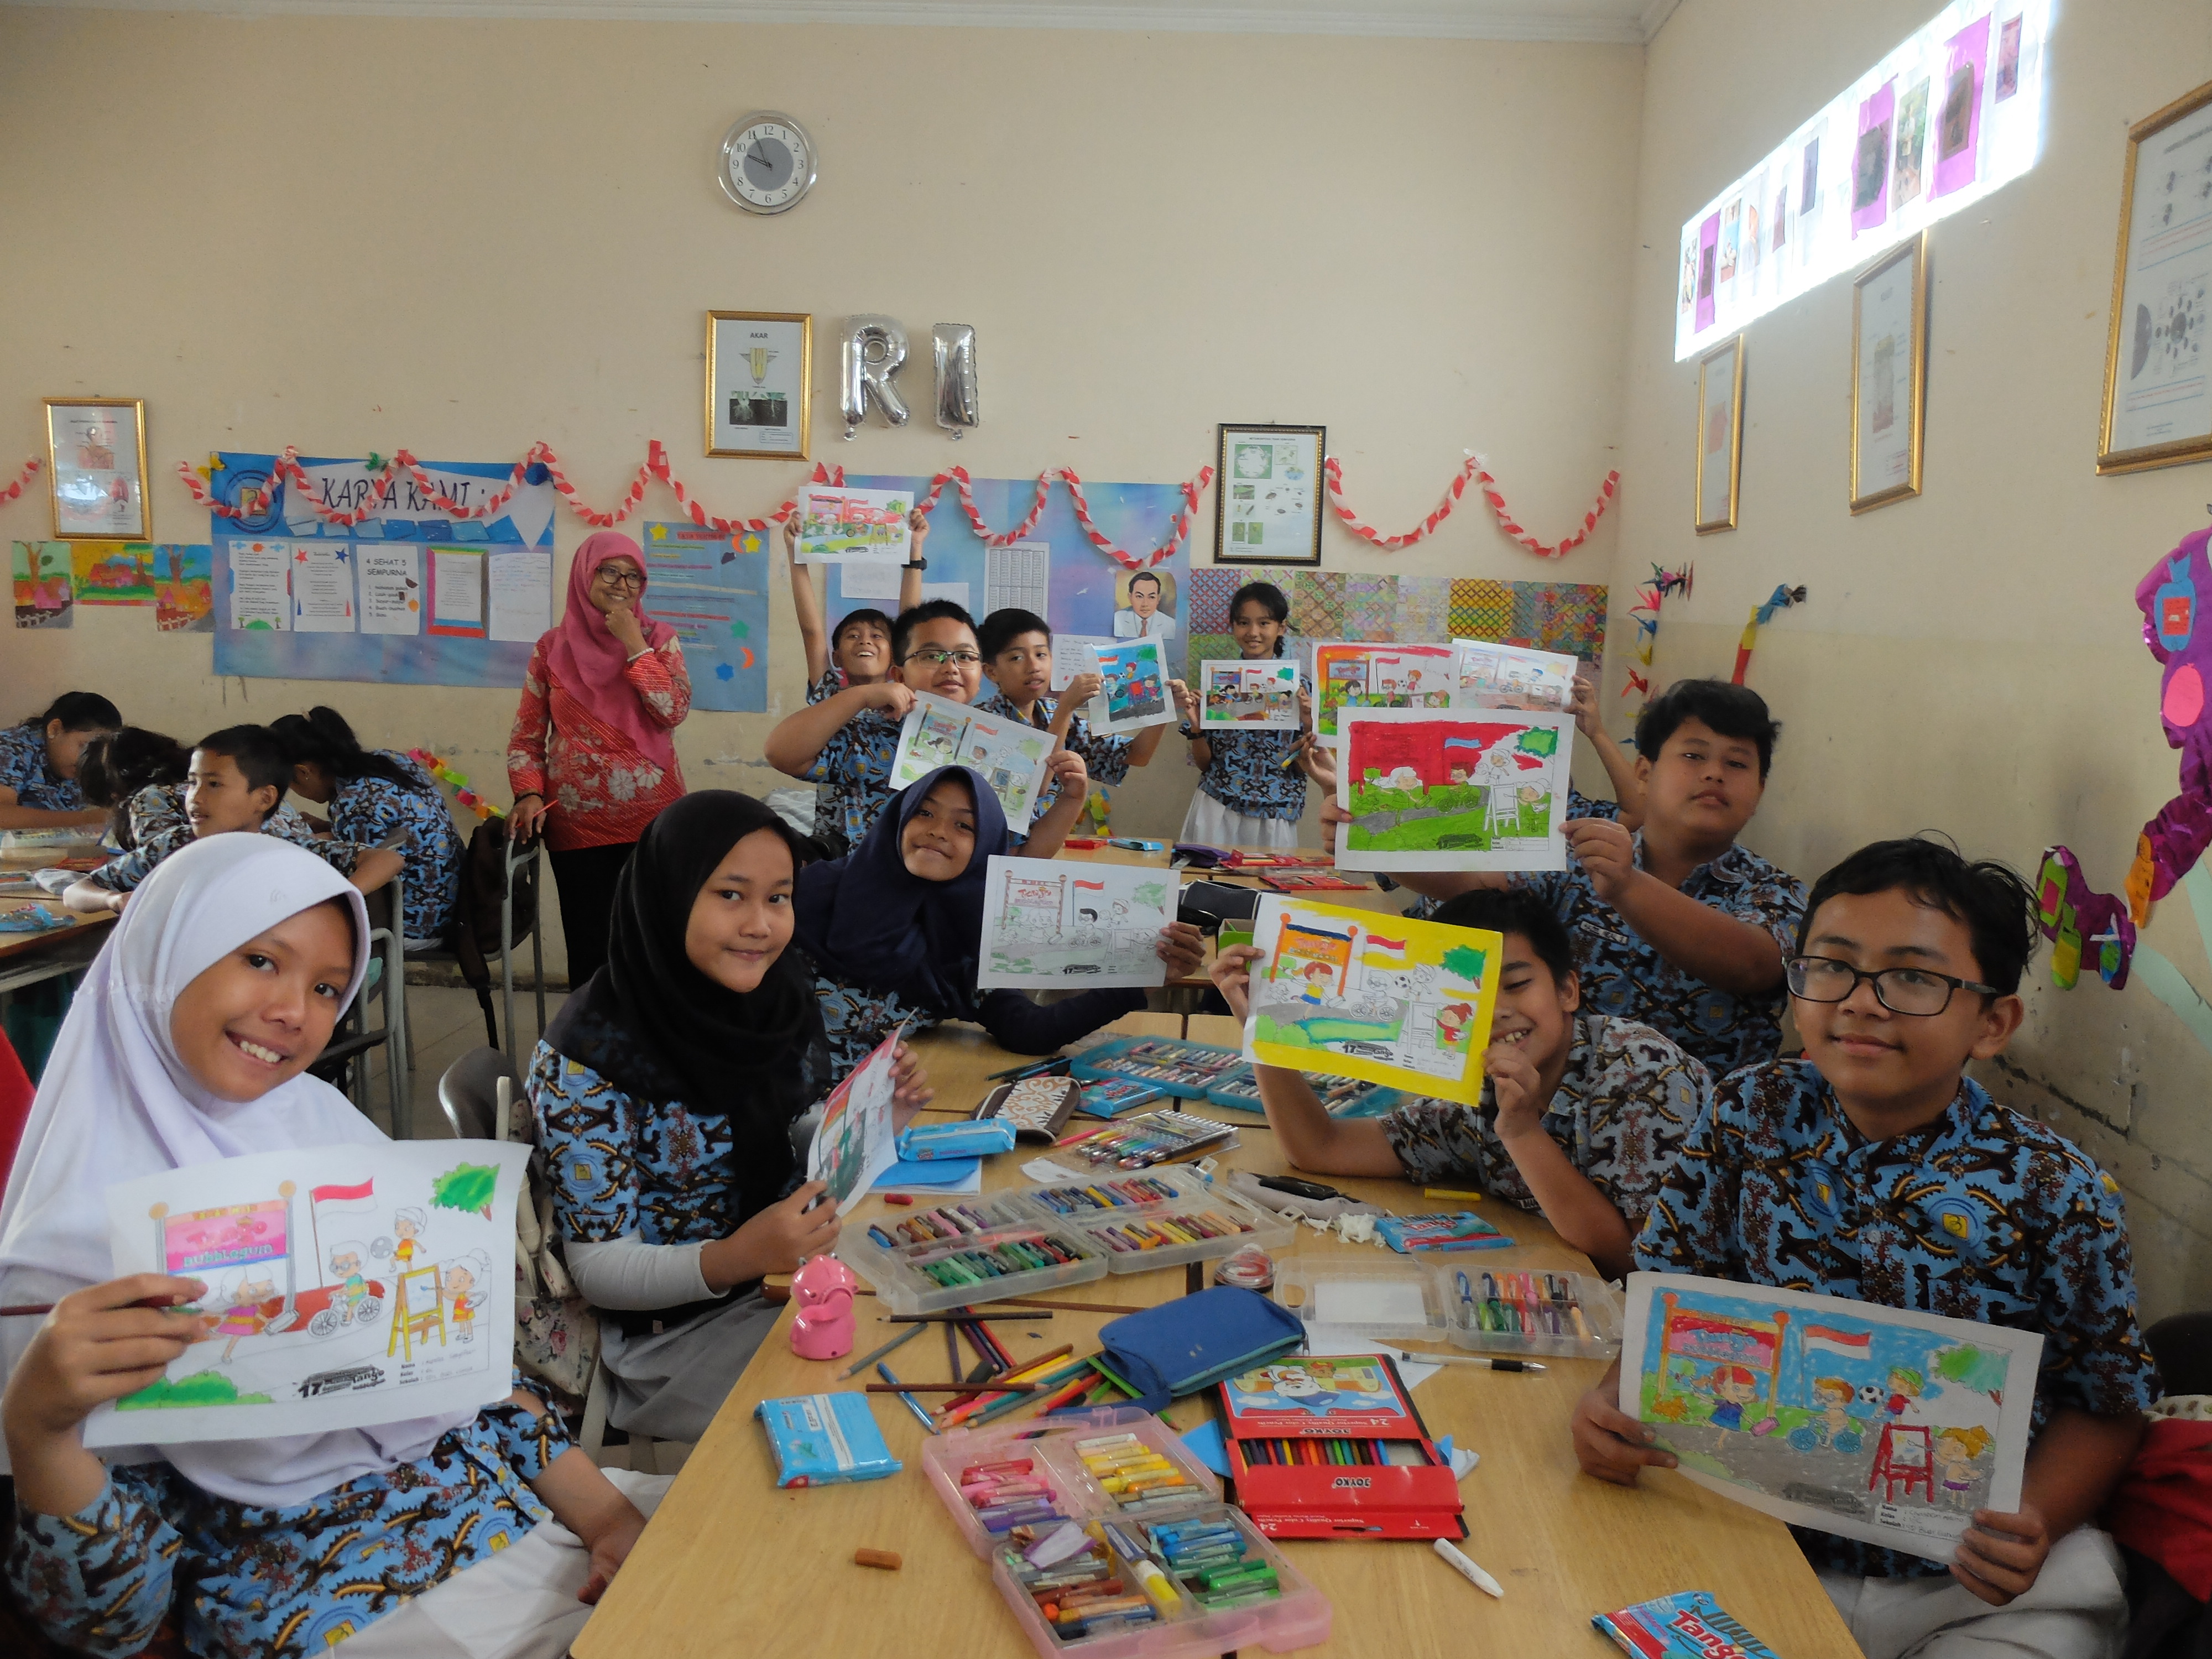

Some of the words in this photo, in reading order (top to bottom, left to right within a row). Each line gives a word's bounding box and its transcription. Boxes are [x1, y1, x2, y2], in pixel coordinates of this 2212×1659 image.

[764, 126, 774, 135] 12
[782, 131, 786, 139] 1
[737, 143, 746, 152] 10
[793, 143, 799, 152] 2
[733, 160, 739, 169] 9
[798, 160, 804, 169] 3
[737, 177, 743, 186] 8
[792, 177, 798, 186] 4
[749, 189, 755, 199] 7
[782, 189, 787, 199] 5
[765, 194, 771, 204] 6
[298, 1383, 322, 1399] 17
[1334, 1477, 1372, 1488] JOYKO
[1260, 1522, 1277, 1531] 24
[1671, 1609, 1749, 1659] Tang
